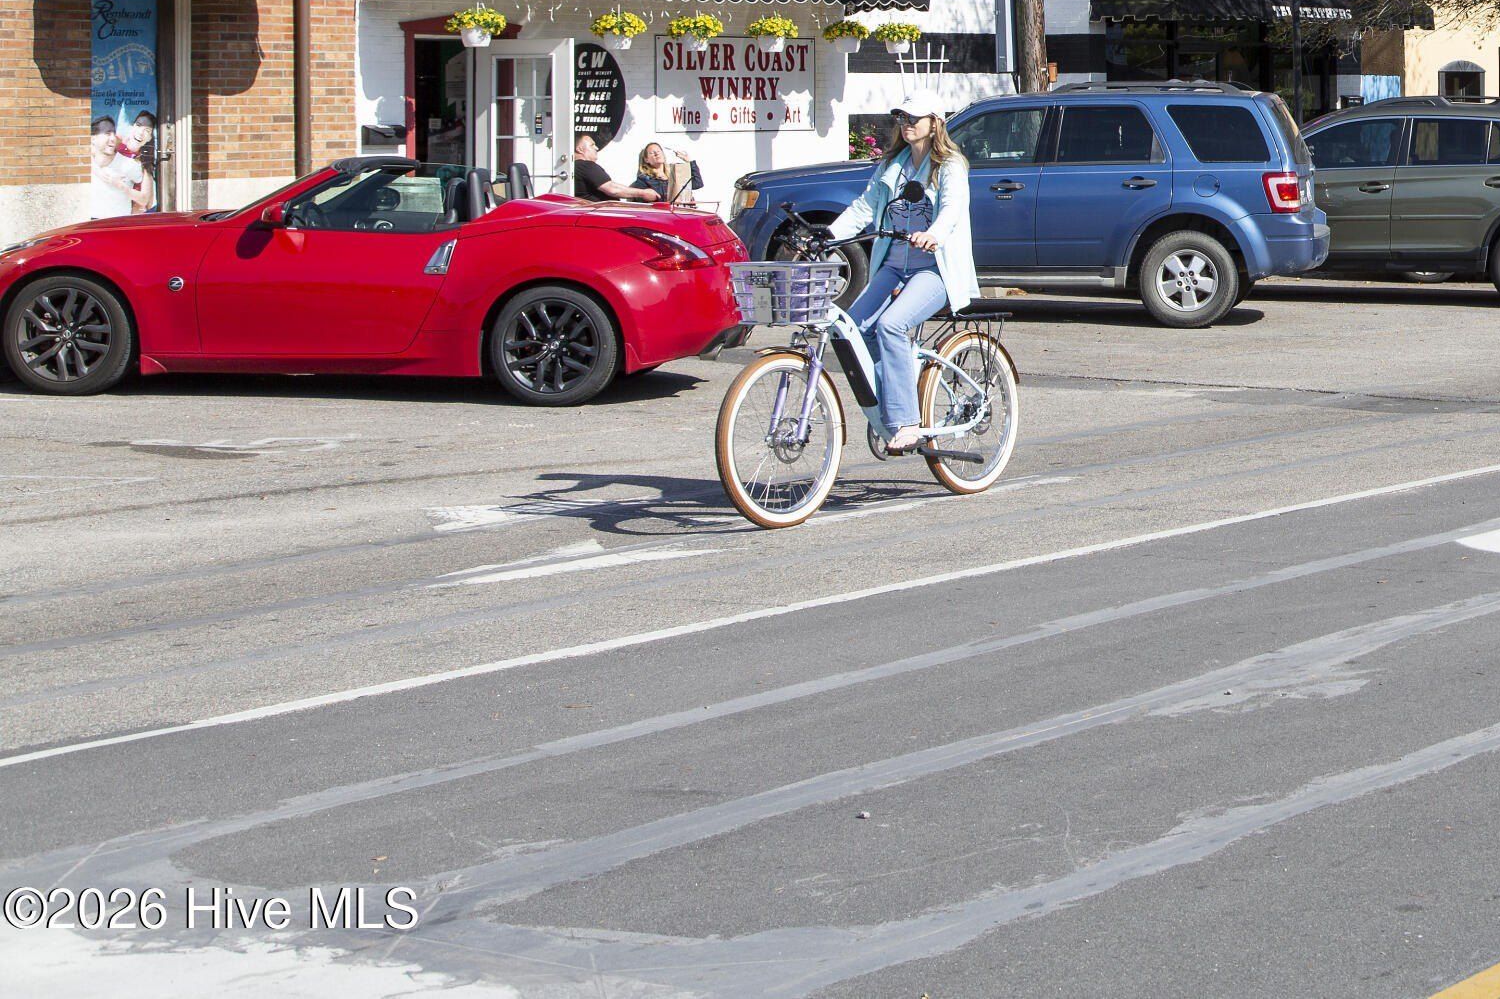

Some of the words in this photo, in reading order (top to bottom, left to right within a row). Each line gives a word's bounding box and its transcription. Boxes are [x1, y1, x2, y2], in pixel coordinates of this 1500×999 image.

[98, 21, 139, 40] Charms
[578, 51, 607, 69] CW
[663, 41, 736, 71] SILVER
[744, 43, 808, 72] COAST
[586, 80, 611, 88] WINE
[698, 77, 780, 101] WINERY
[574, 104, 607, 114] STINGS
[672, 107, 701, 125] Wine
[730, 106, 757, 124] Gifts
[784, 106, 801, 123] Art
